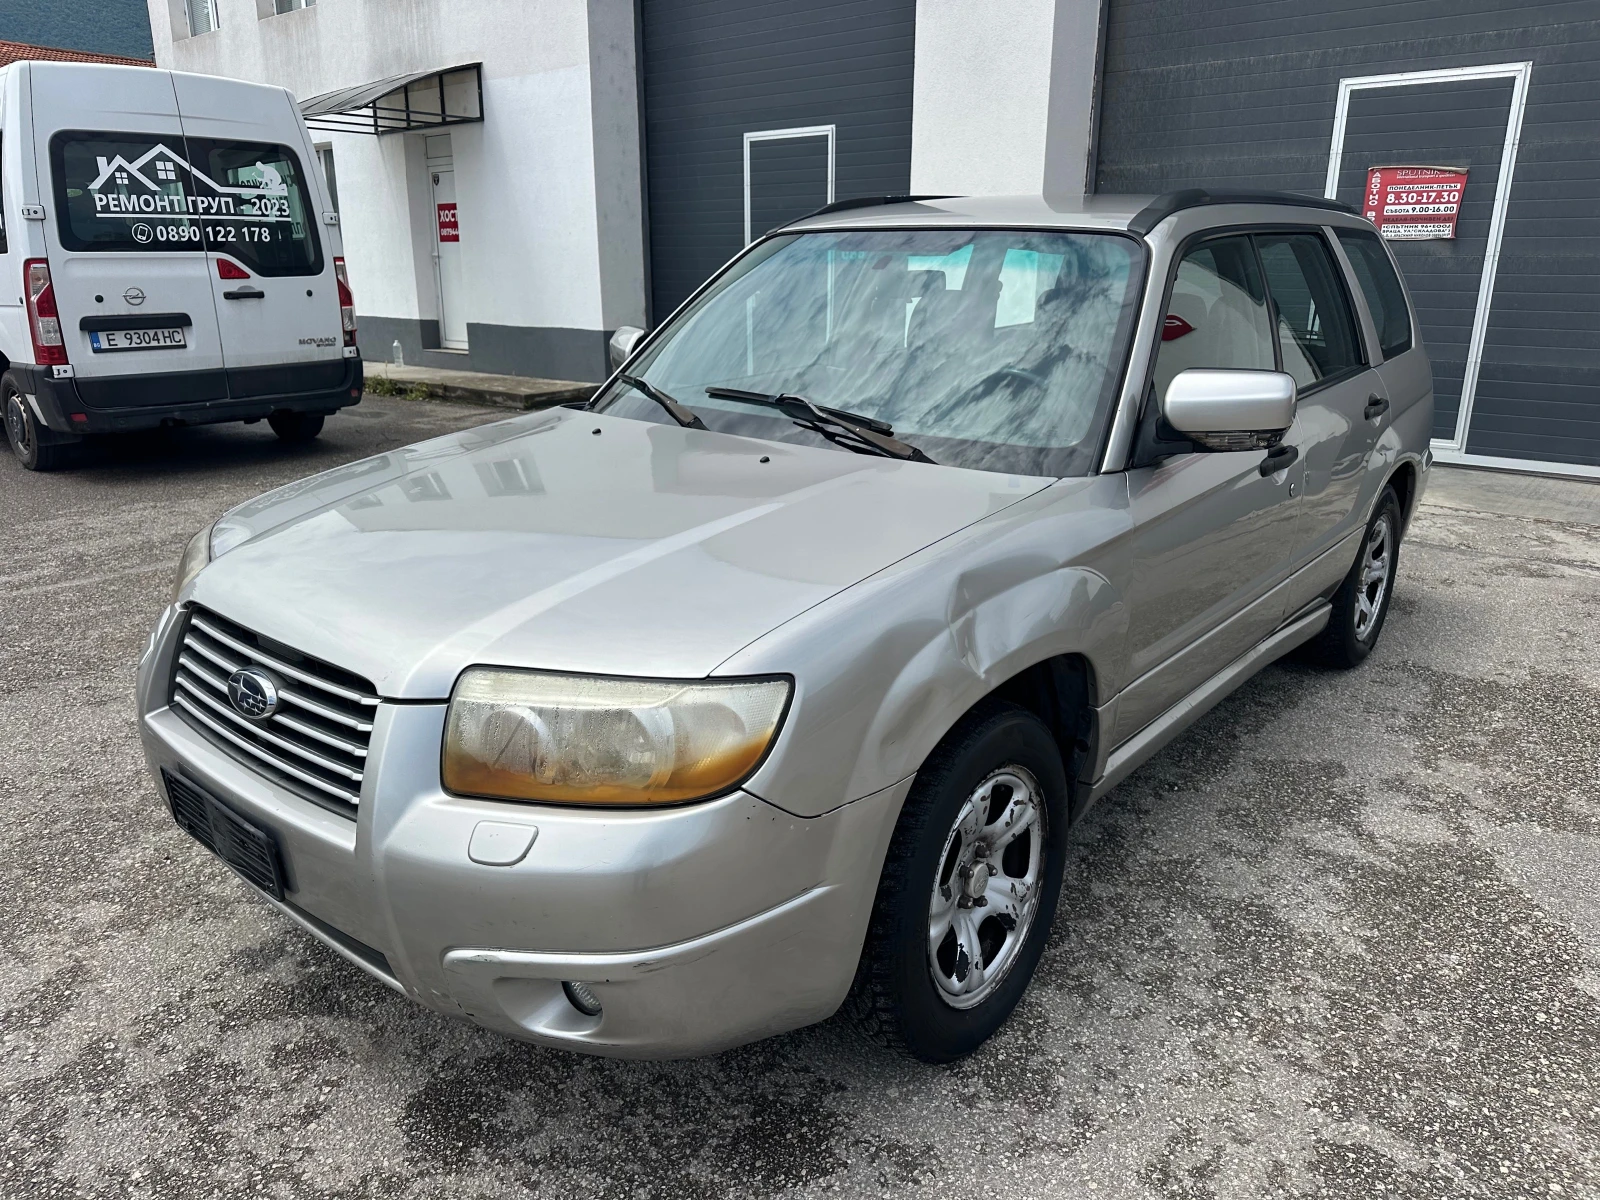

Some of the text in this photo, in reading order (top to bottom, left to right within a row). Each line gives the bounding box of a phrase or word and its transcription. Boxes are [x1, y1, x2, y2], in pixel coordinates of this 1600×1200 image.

[1368, 169, 1382, 206] АБОТНО
[94, 193, 181, 212] РЕМОНТ
[187, 196, 235, 214] ГРУП
[251, 198, 290, 216] 2023
[1386, 192, 1459, 203] 8.30-17.30
[1411, 205, 1455, 213] 9.00-16.00
[156, 225, 271, 242] 0890 122 178
[106, 333, 118, 347] E
[298, 336, 337, 345] MOVANO
